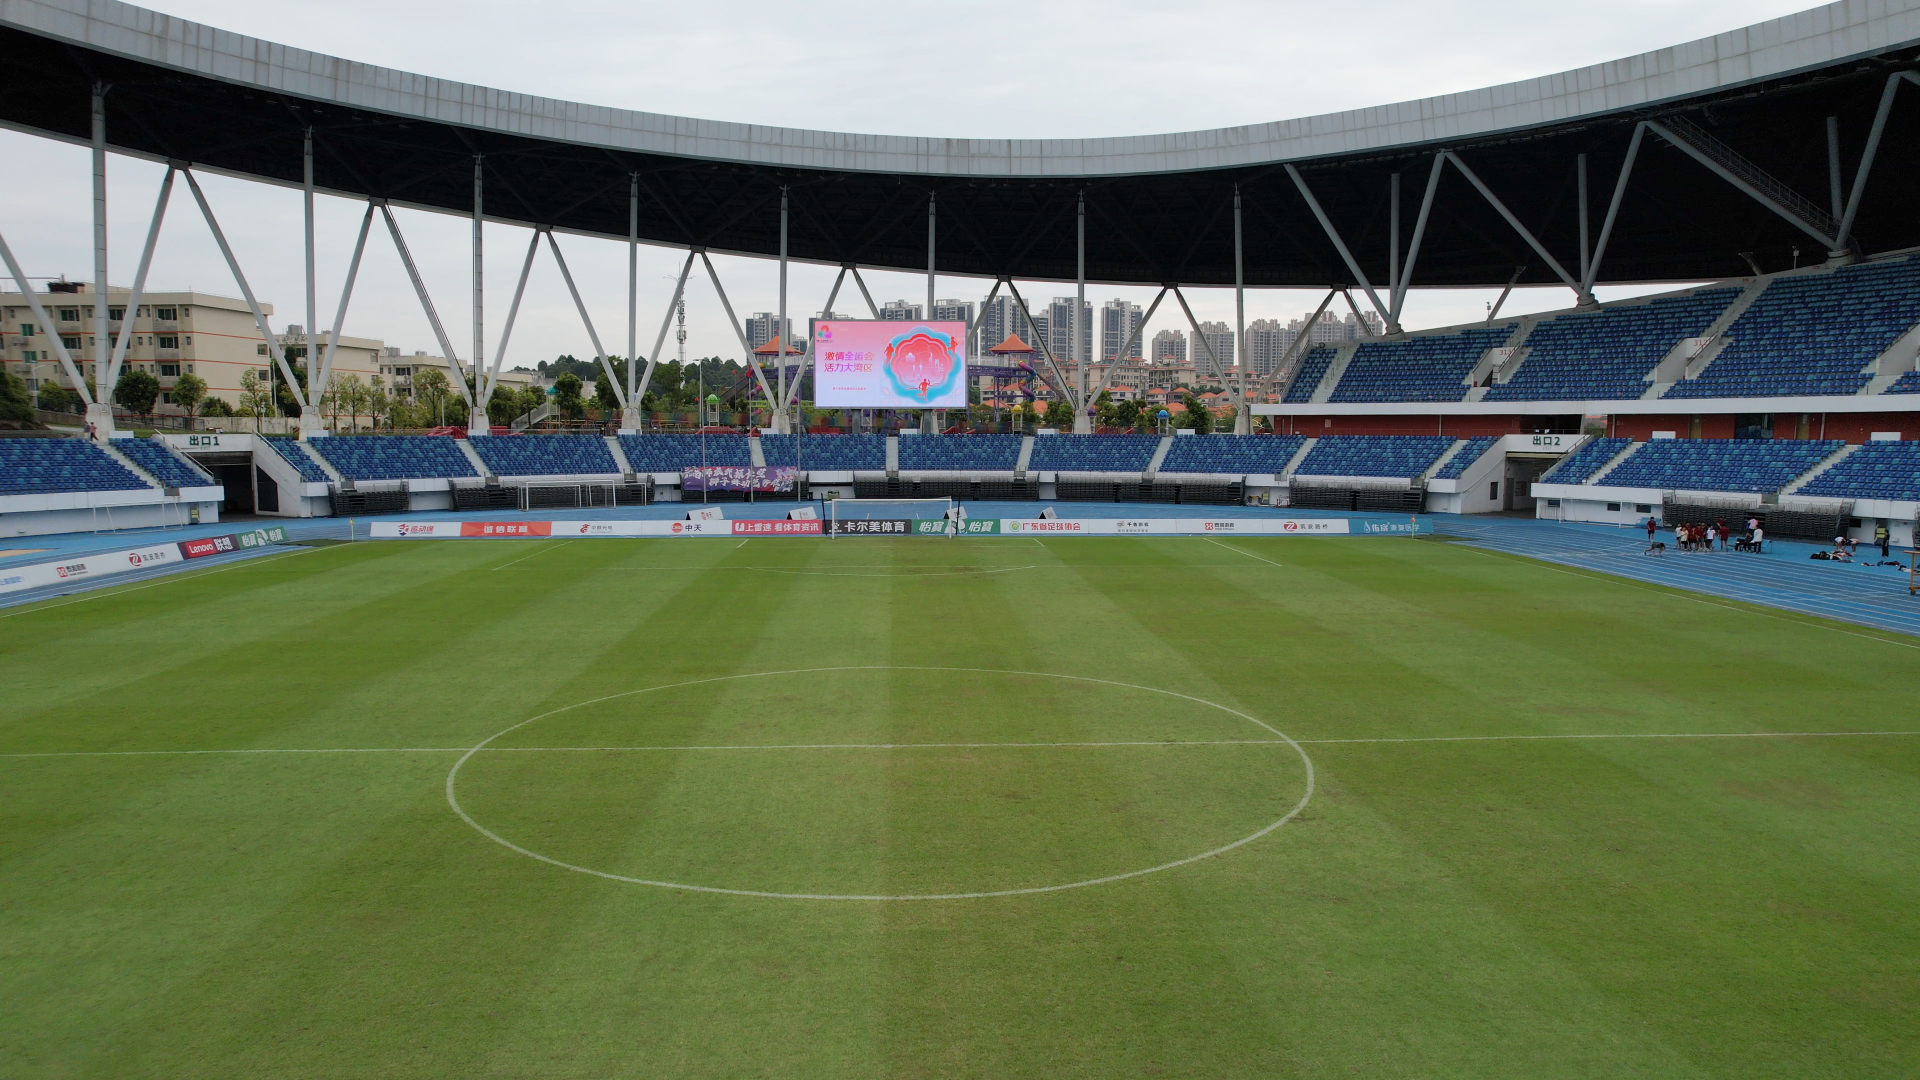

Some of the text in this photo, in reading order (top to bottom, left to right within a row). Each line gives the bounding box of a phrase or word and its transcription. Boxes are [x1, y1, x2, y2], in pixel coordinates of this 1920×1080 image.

[824, 351, 874, 361] 激情全运会
[824, 363, 873, 372] 活力大湾区
[189, 435, 220, 446] 出口1
[1532, 435, 1560, 446] 出口2
[745, 523, 819, 532] 上雷速 看体育资讯
[844, 521, 905, 532] 卡尔美体育
[1022, 522, 1081, 531] 广东省足球协会
[188, 537, 233, 554] Lenovo 联想
